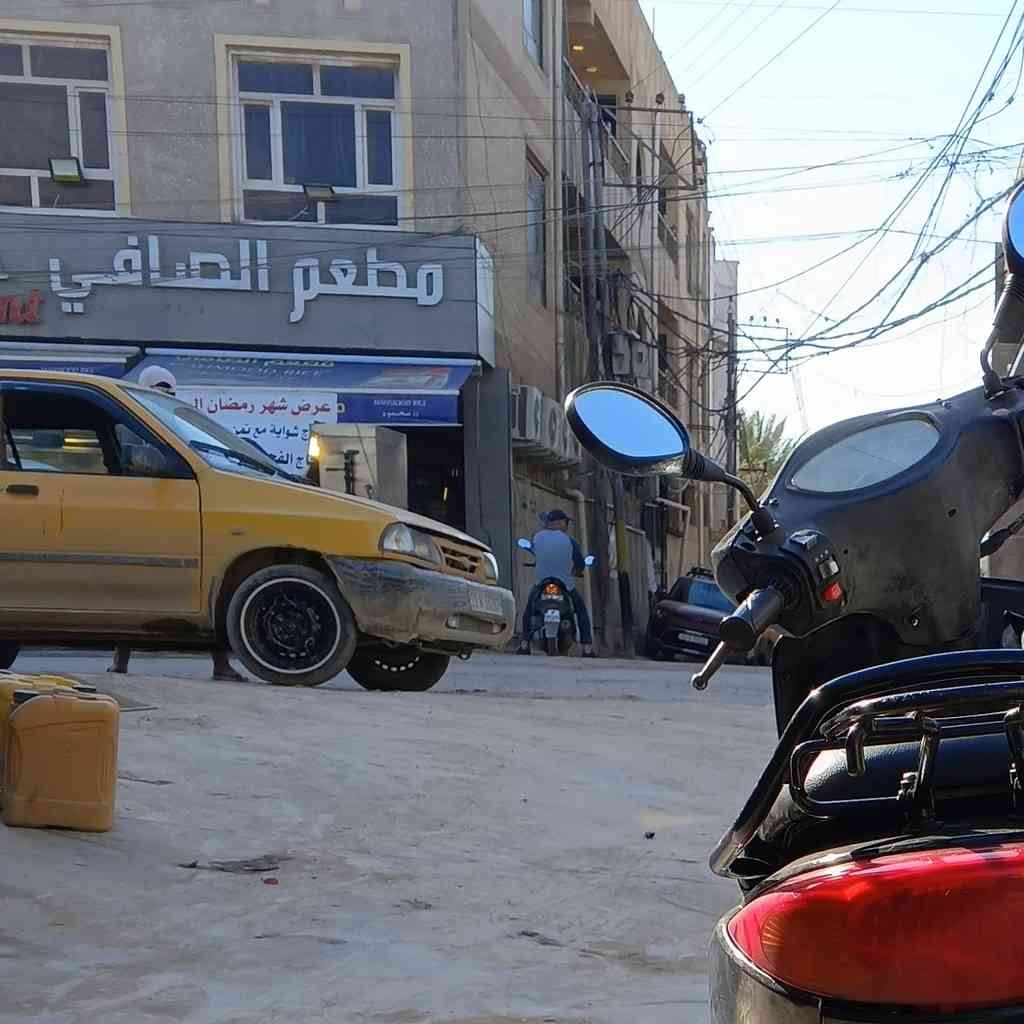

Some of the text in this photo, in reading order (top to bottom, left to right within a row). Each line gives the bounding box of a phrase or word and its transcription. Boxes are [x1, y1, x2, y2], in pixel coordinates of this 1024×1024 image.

[50, 235, 443, 322] مطعم الصافي
[207, 397, 255, 413] رمضان
[259, 397, 288, 415] شهر
[291, 399, 331, 415] عرض
[252, 426, 267, 438] مع
[269, 425, 299, 439] شواية
[270, 450, 294, 465] الفح
